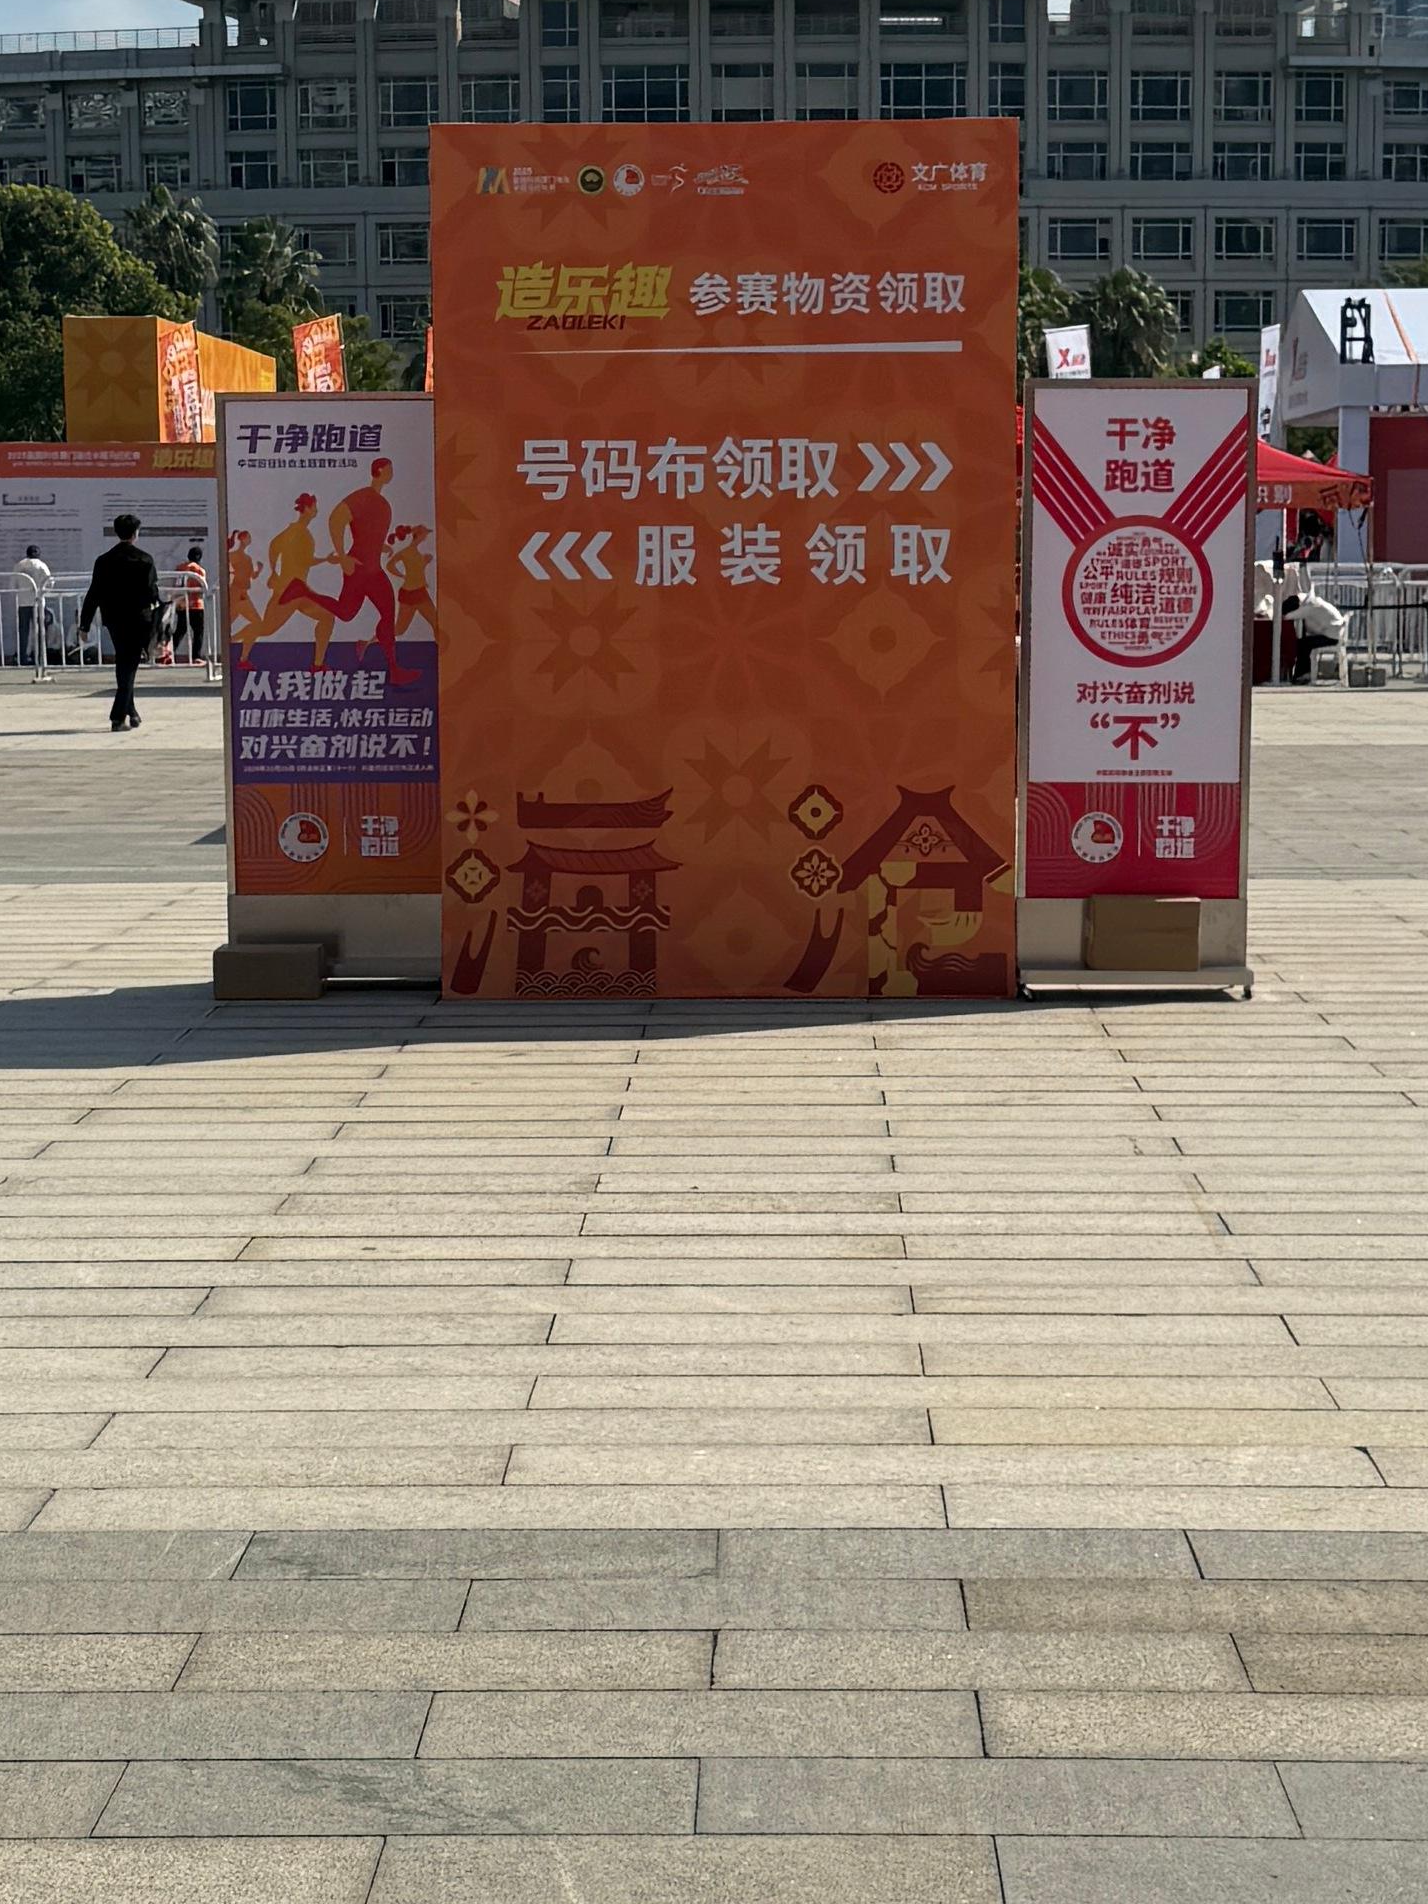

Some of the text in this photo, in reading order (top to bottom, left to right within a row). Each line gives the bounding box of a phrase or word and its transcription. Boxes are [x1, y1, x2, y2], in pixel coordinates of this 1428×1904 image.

[912, 162, 988, 182] 文广体育
[494, 260, 966, 320] 造乐趣 参赛物资领取
[236, 423, 383, 454] 干净跑道
[1106, 416, 1176, 451] 干净
[516, 436, 839, 500] 号码布领取
[1104, 458, 1175, 493] 跑道
[635, 523, 953, 586] 服装领取
[1144, 556, 1186, 567] SPORT
[1083, 565, 1114, 580] 公平
[1116, 570, 1157, 581] RULES
[1110, 583, 1156, 605] 纯洁
[1159, 585, 1197, 595] CLEAN
[239, 670, 387, 701] 从我做起
[1076, 680, 1196, 704] 对兴奋剂说
